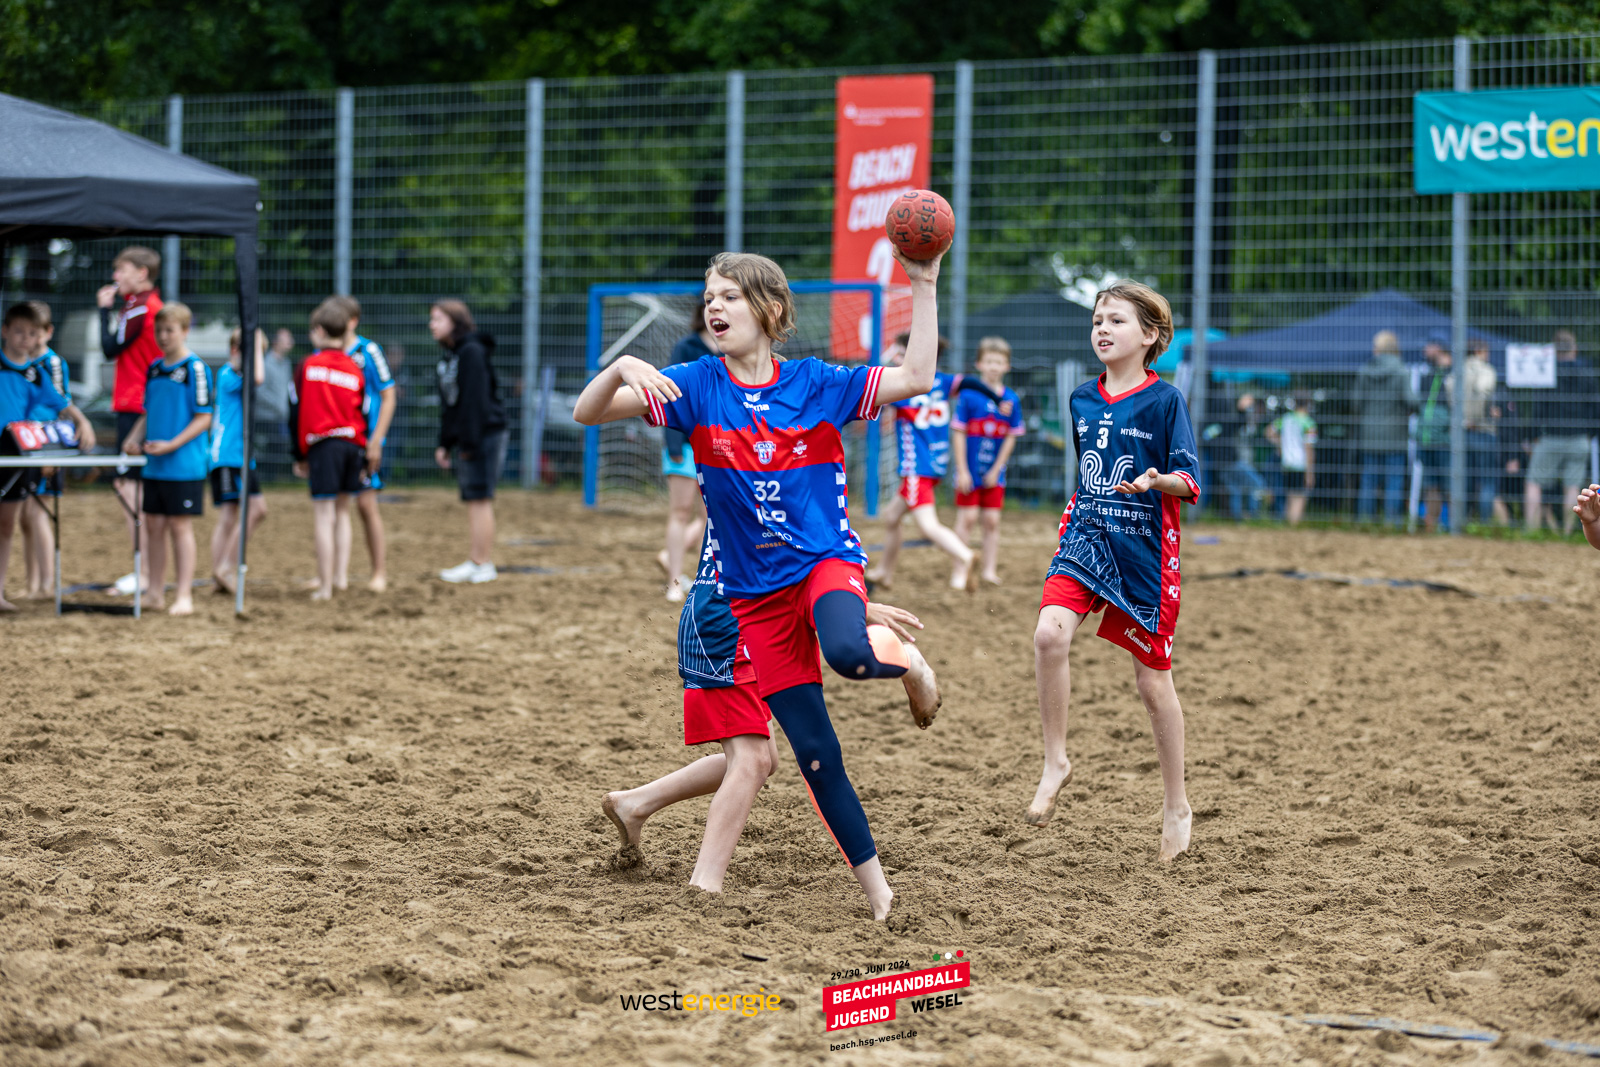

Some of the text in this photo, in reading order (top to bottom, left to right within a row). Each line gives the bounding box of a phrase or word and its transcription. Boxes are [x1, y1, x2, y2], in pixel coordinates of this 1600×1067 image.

[847, 142, 917, 190] BEACH
[919, 197, 937, 245] WESEL
[1096, 427, 1109, 449] 3
[753, 480, 781, 501] 32
[755, 504, 787, 525] ito
